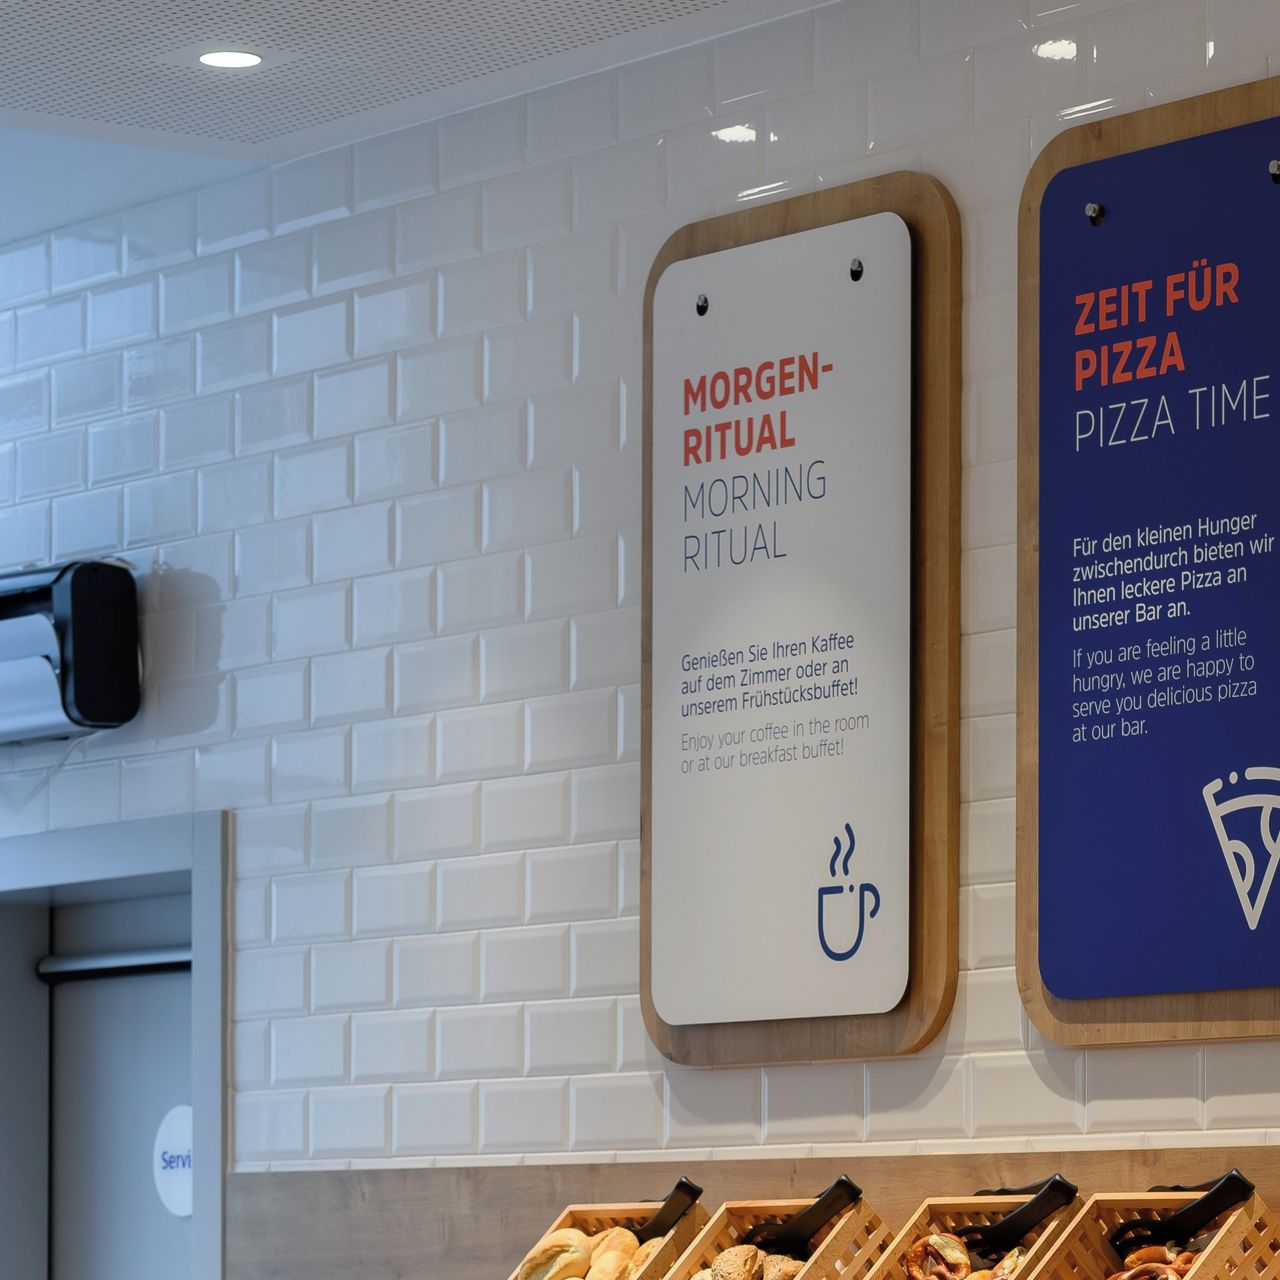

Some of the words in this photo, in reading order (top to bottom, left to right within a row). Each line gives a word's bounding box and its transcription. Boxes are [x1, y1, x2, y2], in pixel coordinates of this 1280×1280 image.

[1075, 280, 1152, 335] ZEIT
[1166, 258, 1239, 316] FÜR
[1075, 331, 1185, 391] PIZZA
[684, 352, 833, 416] MORGEN-
[1076, 395, 1175, 452] PIZZA
[1188, 375, 1270, 430] TIME
[684, 411, 795, 466] RITUAL
[684, 460, 825, 522] MORNING
[684, 521, 787, 573] RITUAL
[1074, 537, 1097, 557] Für
[1102, 533, 1131, 552] den
[1138, 525, 1192, 547] kleinen
[1199, 514, 1257, 537] Hunger
[1073, 547, 1187, 582] zwischendurch
[1194, 542, 1243, 563] bieten
[1250, 533, 1274, 554] wir
[1074, 587, 1115, 607] Ihnen
[1122, 578, 1175, 599] leckere
[1182, 570, 1221, 590] Pizza
[1227, 567, 1246, 583] an
[1073, 610, 1130, 631] unserer
[1136, 603, 1162, 622] Bar
[1168, 601, 1190, 618] an.
[682, 649, 743, 671] Genießen
[749, 645, 767, 662] Sie
[773, 642, 806, 658] Ihren
[812, 633, 854, 653] Kaffee
[1073, 648, 1082, 668] If
[1087, 649, 1112, 669] you
[1118, 645, 1141, 662] are
[1146, 636, 1195, 658] feeling
[1201, 636, 1210, 650] a
[1216, 627, 1246, 648] little
[682, 675, 702, 694] auf
[707, 674, 735, 691] dem
[741, 667, 791, 686] Zimmer
[796, 660, 827, 679] oder
[832, 659, 848, 674] an
[1073, 673, 1125, 693] hungry,
[1131, 669, 1152, 685] we
[1158, 665, 1181, 681] are
[1187, 658, 1234, 678] happy
[1239, 653, 1254, 671] to
[682, 698, 737, 717] unserem
[743, 677, 857, 709] Frühstücksbuffet!
[1073, 699, 1110, 717] serve
[1116, 696, 1141, 715] you
[1148, 685, 1212, 708] delicious
[1218, 679, 1256, 702] pizza
[682, 733, 714, 751] Enjoy
[718, 731, 745, 749] your
[750, 723, 788, 742] coffee
[793, 720, 804, 736] in
[809, 718, 830, 735] the
[835, 714, 869, 732] room
[1072, 724, 1087, 742] at
[1092, 723, 1116, 740] our
[1122, 718, 1147, 736] bar.
[681, 760, 694, 774] or
[698, 755, 710, 771] at
[715, 755, 735, 770] our
[740, 744, 797, 767] breakfast
[802, 737, 843, 760] buffet!
